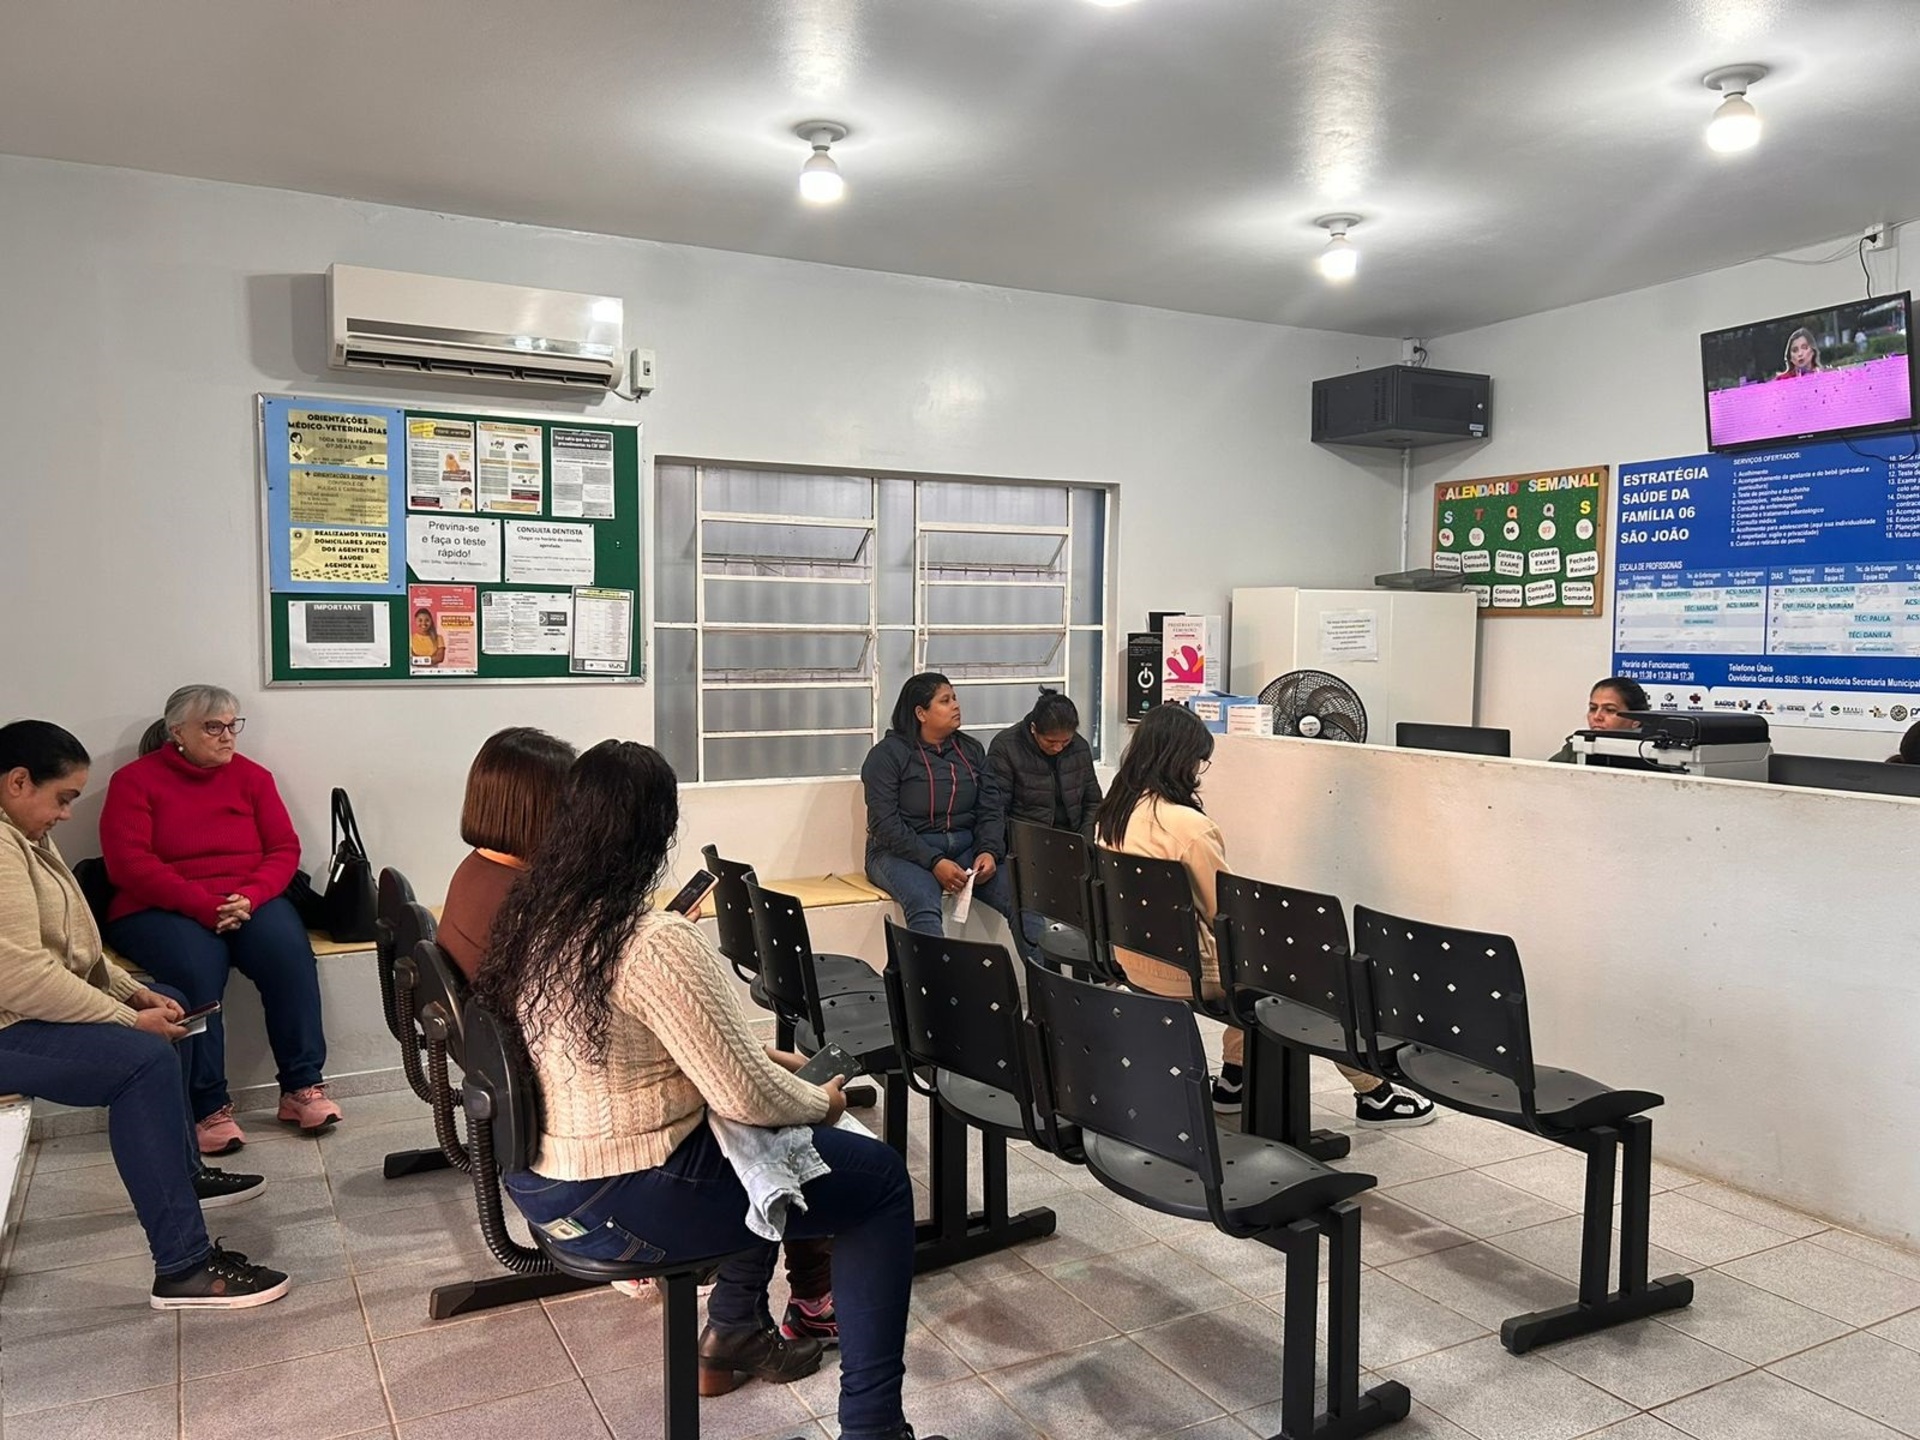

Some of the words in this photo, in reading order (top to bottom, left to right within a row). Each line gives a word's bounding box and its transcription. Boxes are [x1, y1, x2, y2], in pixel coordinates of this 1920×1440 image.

[307, 414, 368, 424] ORIENTAÇÕES
[288, 421, 387, 434] MÉDICO-VETERINÁRIAS
[1733, 457, 1762, 465] SERVIÇOS
[1763, 452, 1801, 462] OFERTADOS:
[1623, 466, 1709, 486] ESTRATÉGIA
[1738, 475, 1781, 483] Acompanhamento
[1789, 472, 1811, 480] gestante
[1438, 481, 1519, 500] CALENDARIO
[1528, 472, 1599, 492] SEMANAL
[1622, 489, 1668, 505] SAÚDE
[1671, 488, 1690, 500] DA
[1444, 511, 1453, 524] S
[1475, 509, 1484, 521] T
[1507, 506, 1518, 519] Q
[1543, 503, 1555, 517] Q
[1580, 501, 1591, 514] S
[1622, 507, 1675, 523] FAMÍLIA
[1678, 506, 1696, 518] 06
[428, 520, 479, 533] Previna-se
[1620, 530, 1648, 543] SÃO
[1651, 526, 1689, 542] JOÃO
[431, 535, 451, 546] faça
[463, 537, 486, 546] teste
[438, 549, 471, 558] rápido!
[1620, 562, 1638, 571] ESCALA
[1638, 562, 1645, 570] DE
[1645, 561, 1683, 570] PROFISSIONAIS
[1870, 565, 1898, 573] Enfermagem
[1528, 584, 1553, 593] Consulta
[1528, 593, 1554, 601] Demanda
[1648, 661, 1690, 670] Funcionamento:
[1728, 663, 1755, 672] Telefone
[1756, 662, 1774, 672] Úteis
[1632, 670, 1638, 679] às
[1639, 671, 1652, 679] 11:30
[1658, 671, 1671, 679] 13:30
[1672, 672, 1679, 680] às
[1680, 672, 1694, 680] 17:30
[1728, 674, 1756, 683] Ouvidoria
[1758, 674, 1774, 683] Geral
[1775, 675, 1783, 683] do
[1784, 675, 1800, 684] SUS:
[1801, 676, 1812, 684] 136
[1819, 676, 1850, 685] Ouvidoria
[1852, 677, 1886, 686] Secretaria
[1887, 678, 1920, 688] Municipal
